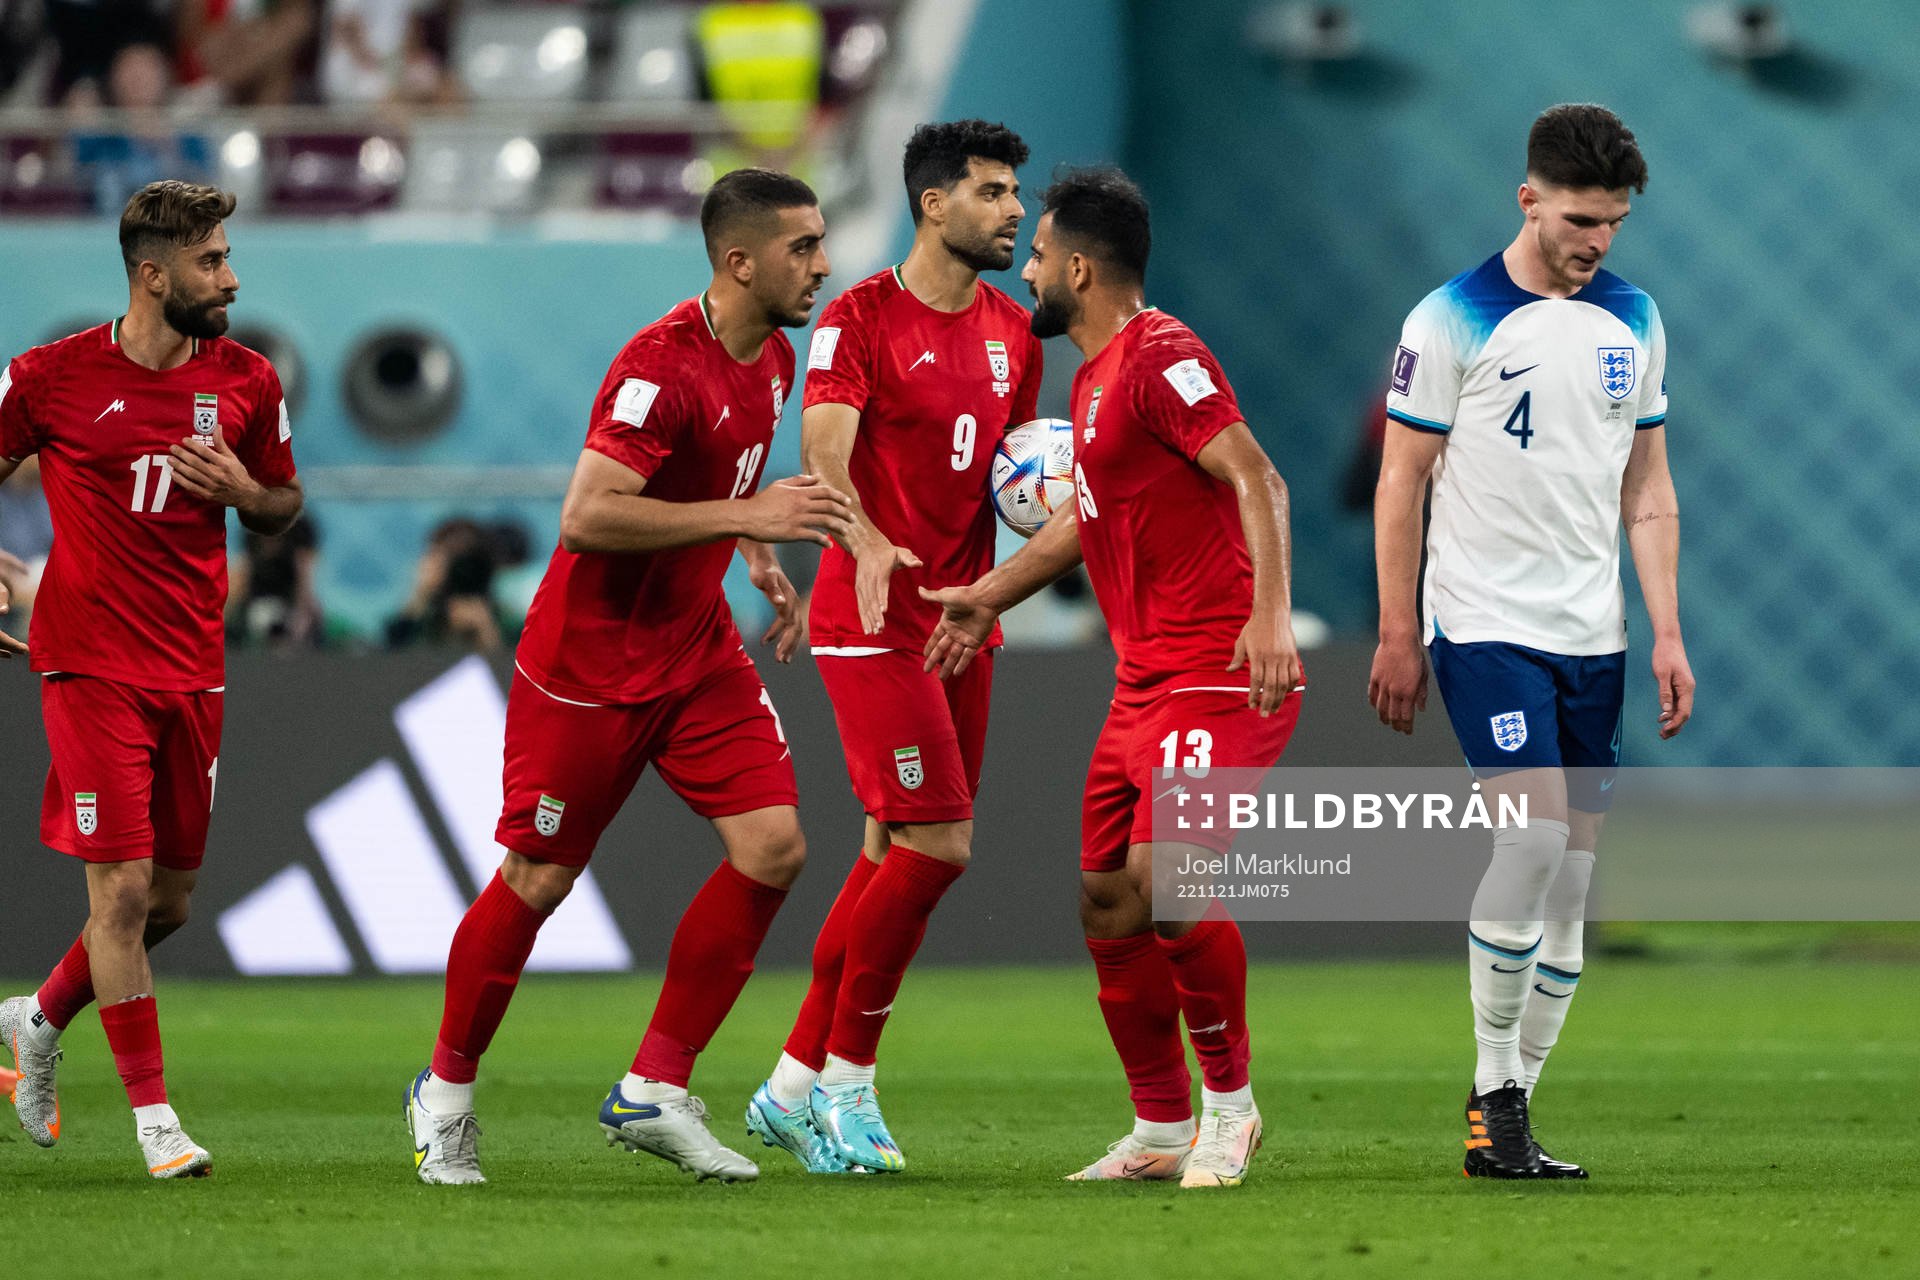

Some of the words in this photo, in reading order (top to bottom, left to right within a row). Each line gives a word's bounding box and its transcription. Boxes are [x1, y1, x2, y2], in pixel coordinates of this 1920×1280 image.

[951, 414, 977, 471] 9
[1503, 391, 1534, 449] 4
[130, 455, 174, 512] 17
[729, 443, 764, 500] 19
[1159, 728, 1213, 779] 13
